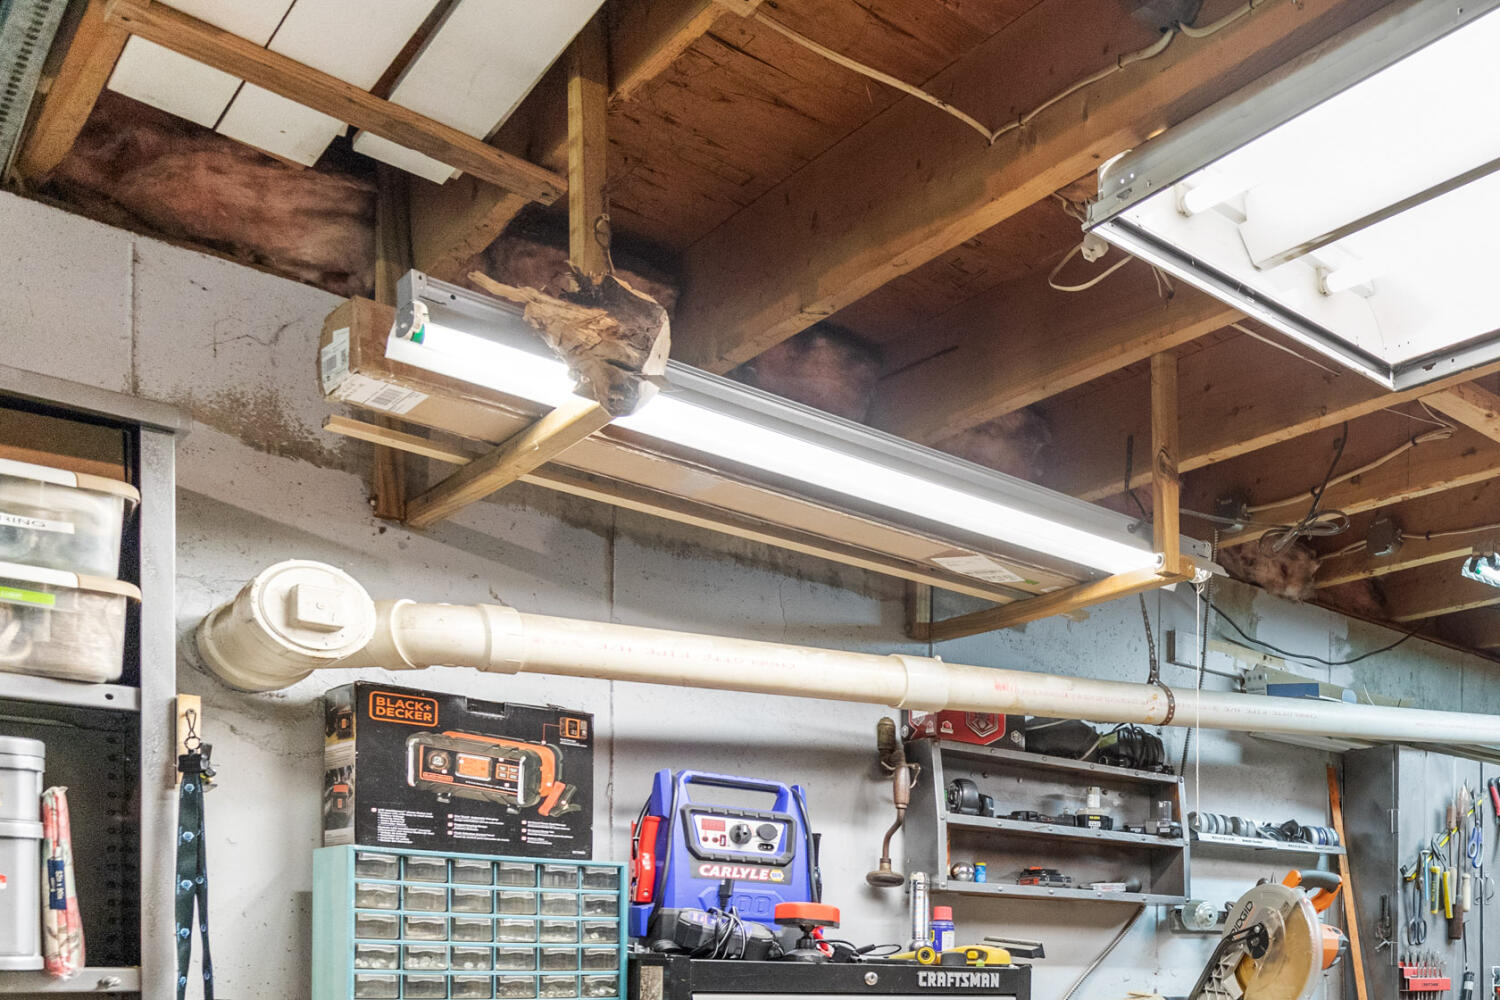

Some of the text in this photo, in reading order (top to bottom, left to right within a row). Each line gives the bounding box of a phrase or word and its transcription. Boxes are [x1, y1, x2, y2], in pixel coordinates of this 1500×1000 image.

[375, 696, 432, 712] BLACK+
[375, 706, 432, 722] DECKER
[699, 864, 770, 880] CARLYLE
[916, 970, 1000, 988] CRAFTSMAN
